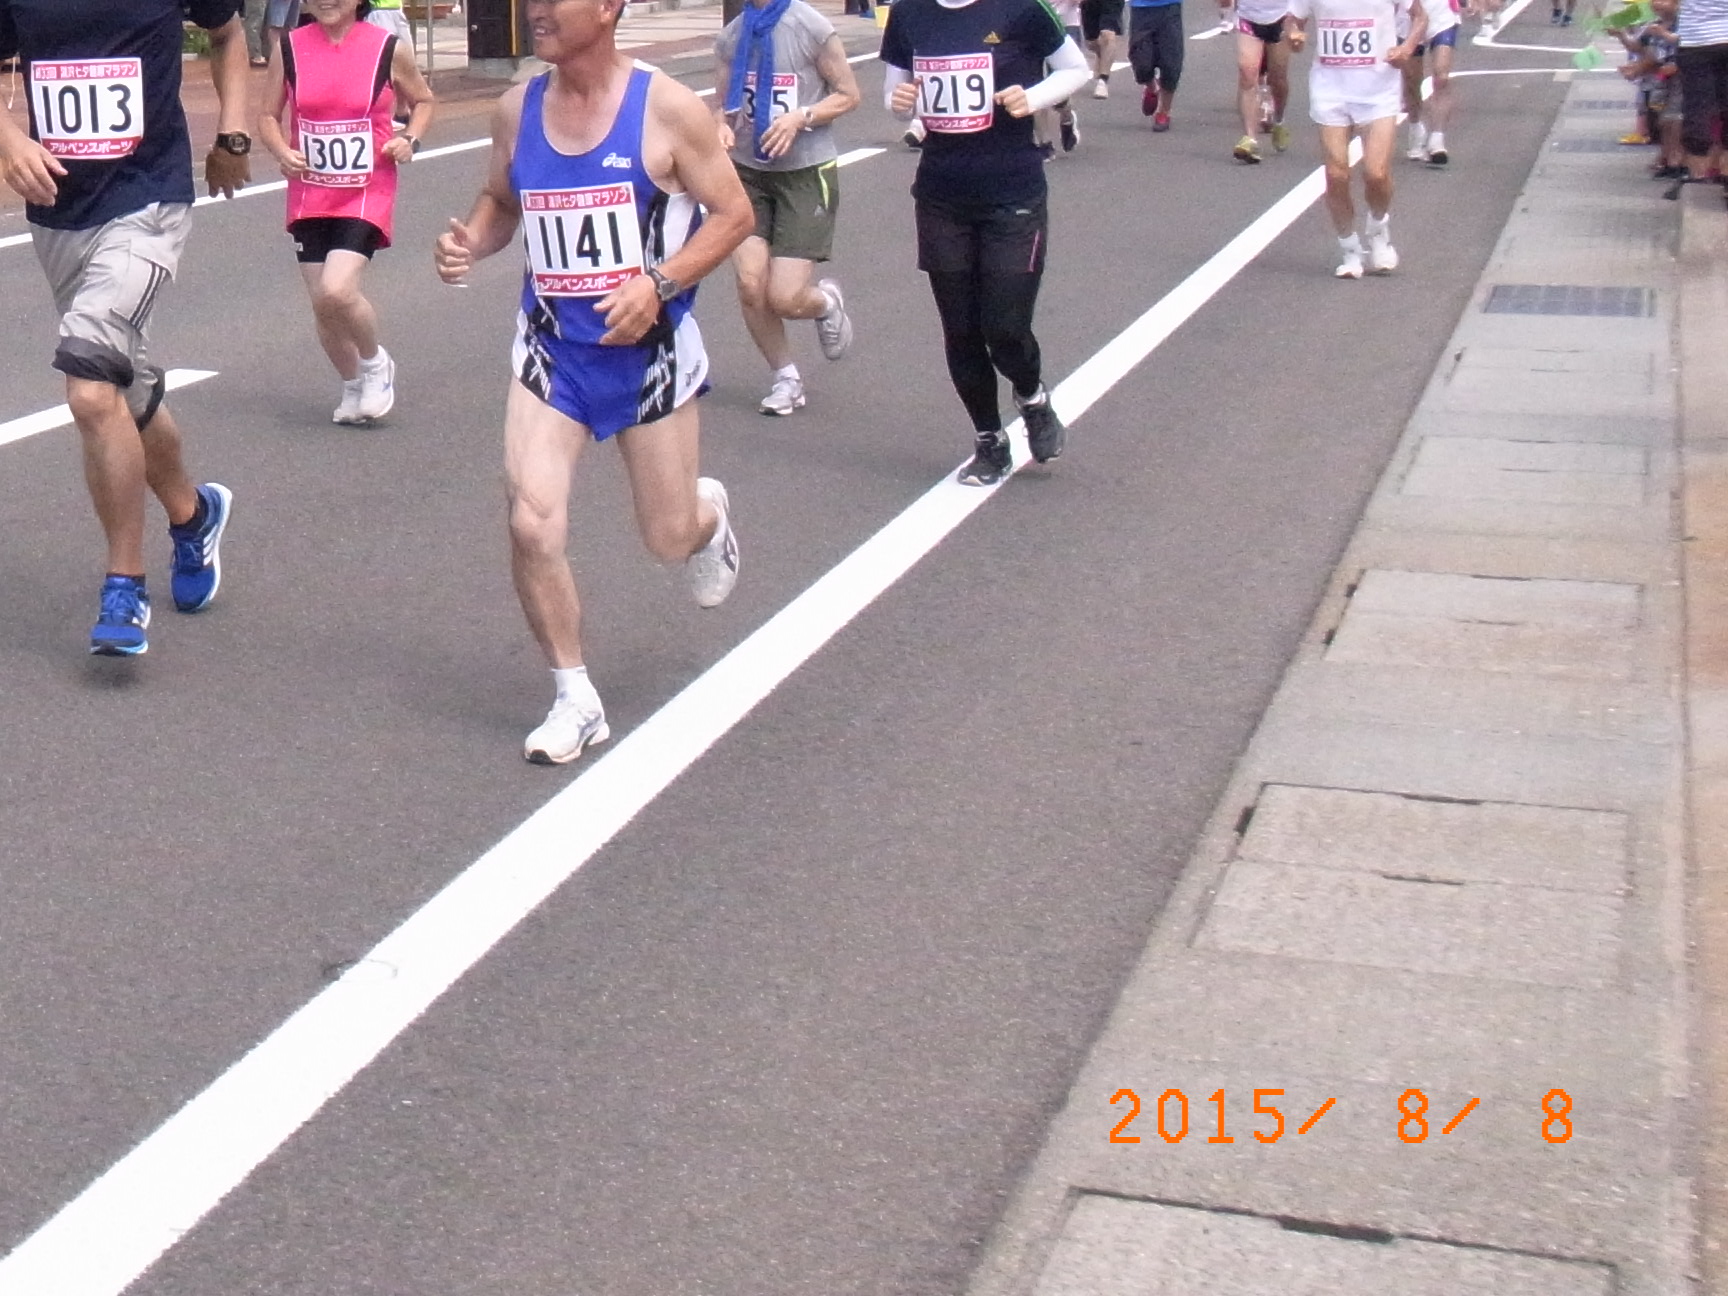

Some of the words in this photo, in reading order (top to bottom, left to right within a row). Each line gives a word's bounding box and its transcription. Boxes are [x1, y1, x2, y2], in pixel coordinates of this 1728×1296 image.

[1323, 29, 1372, 55] 1168
[41, 83, 132, 134] 1013
[919, 73, 986, 114] 1219
[304, 134, 369, 171] 1302
[538, 211, 624, 270] 1141
